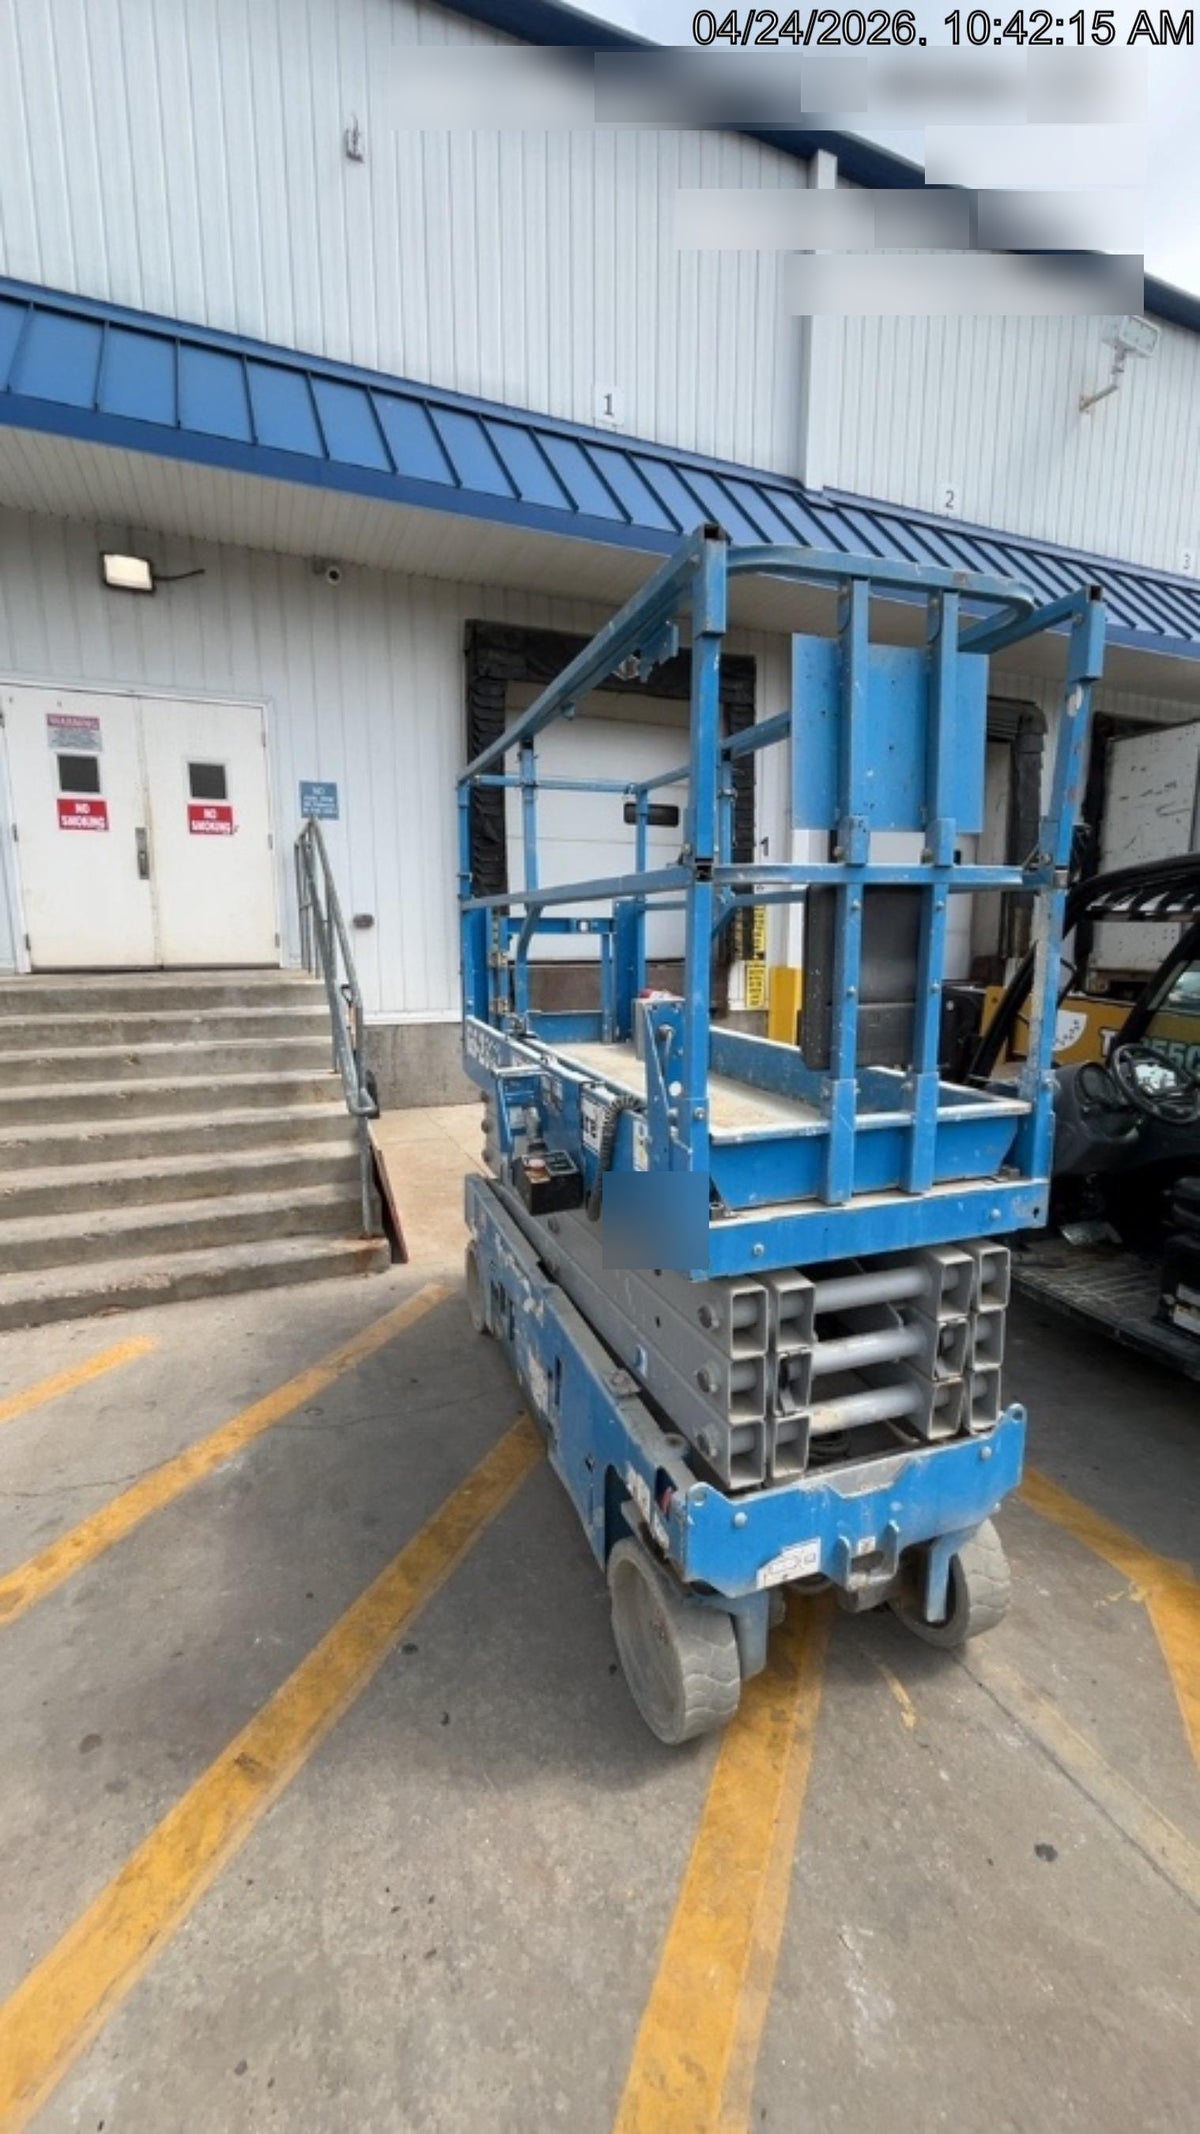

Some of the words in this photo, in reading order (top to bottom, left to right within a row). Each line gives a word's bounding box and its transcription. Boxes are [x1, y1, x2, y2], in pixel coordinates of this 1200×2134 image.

[603, 392, 614, 417] 1
[945, 489, 954, 510] 2
[75, 803, 90, 814] NO
[203, 808, 217, 819] NO
[61, 815, 105, 829] SMOKING
[191, 820, 231, 833] SMOKING
[760, 836, 769, 856] 1
